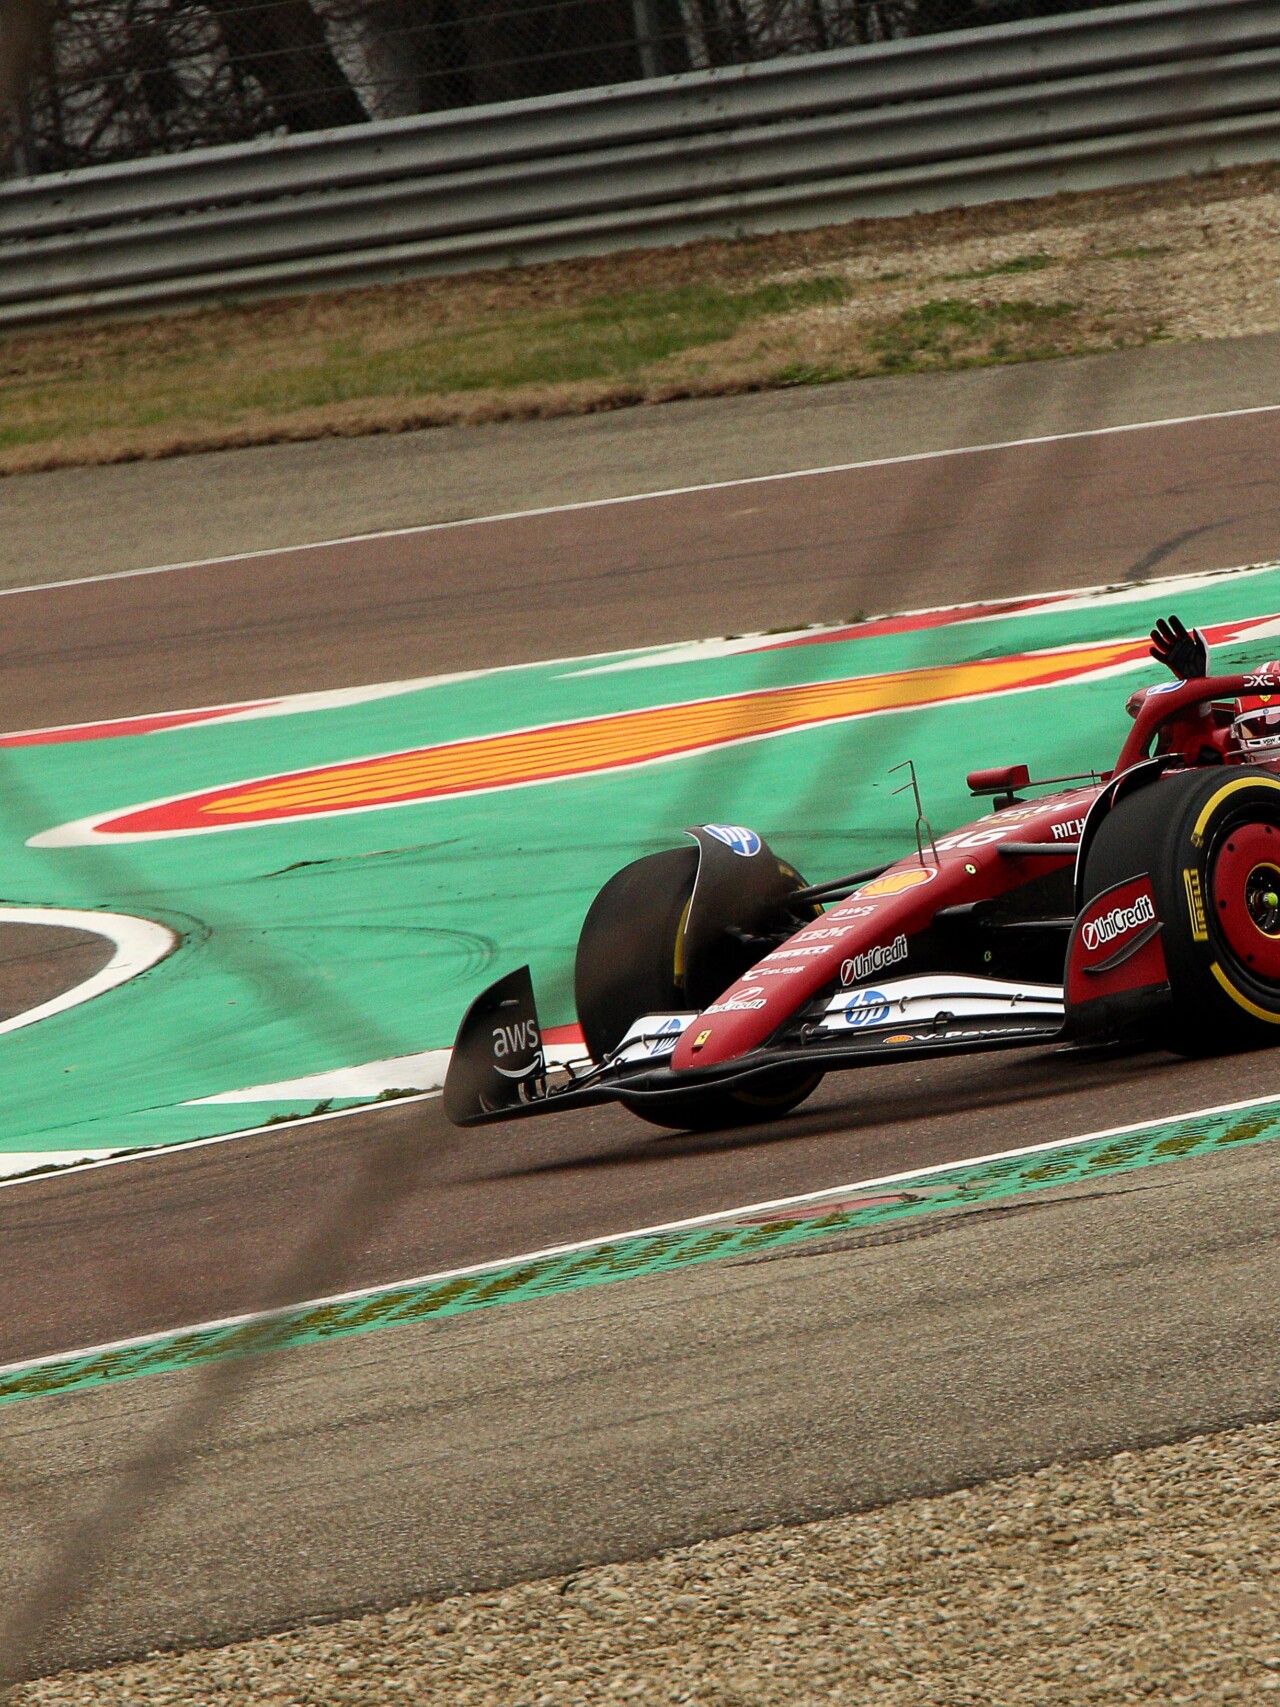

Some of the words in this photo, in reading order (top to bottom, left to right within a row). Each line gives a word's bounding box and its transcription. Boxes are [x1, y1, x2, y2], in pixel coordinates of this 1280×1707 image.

[1243, 675, 1274, 687] DXC
[706, 825, 753, 856] hp
[913, 824, 1024, 855] 16
[832, 904, 878, 917] aws
[1095, 895, 1154, 942] UniCredit
[791, 925, 855, 944] IBM
[854, 934, 908, 979] UniCredit
[849, 991, 888, 1024] hp
[493, 1020, 539, 1057] aws
[915, 1026, 1037, 1041] V-Power
